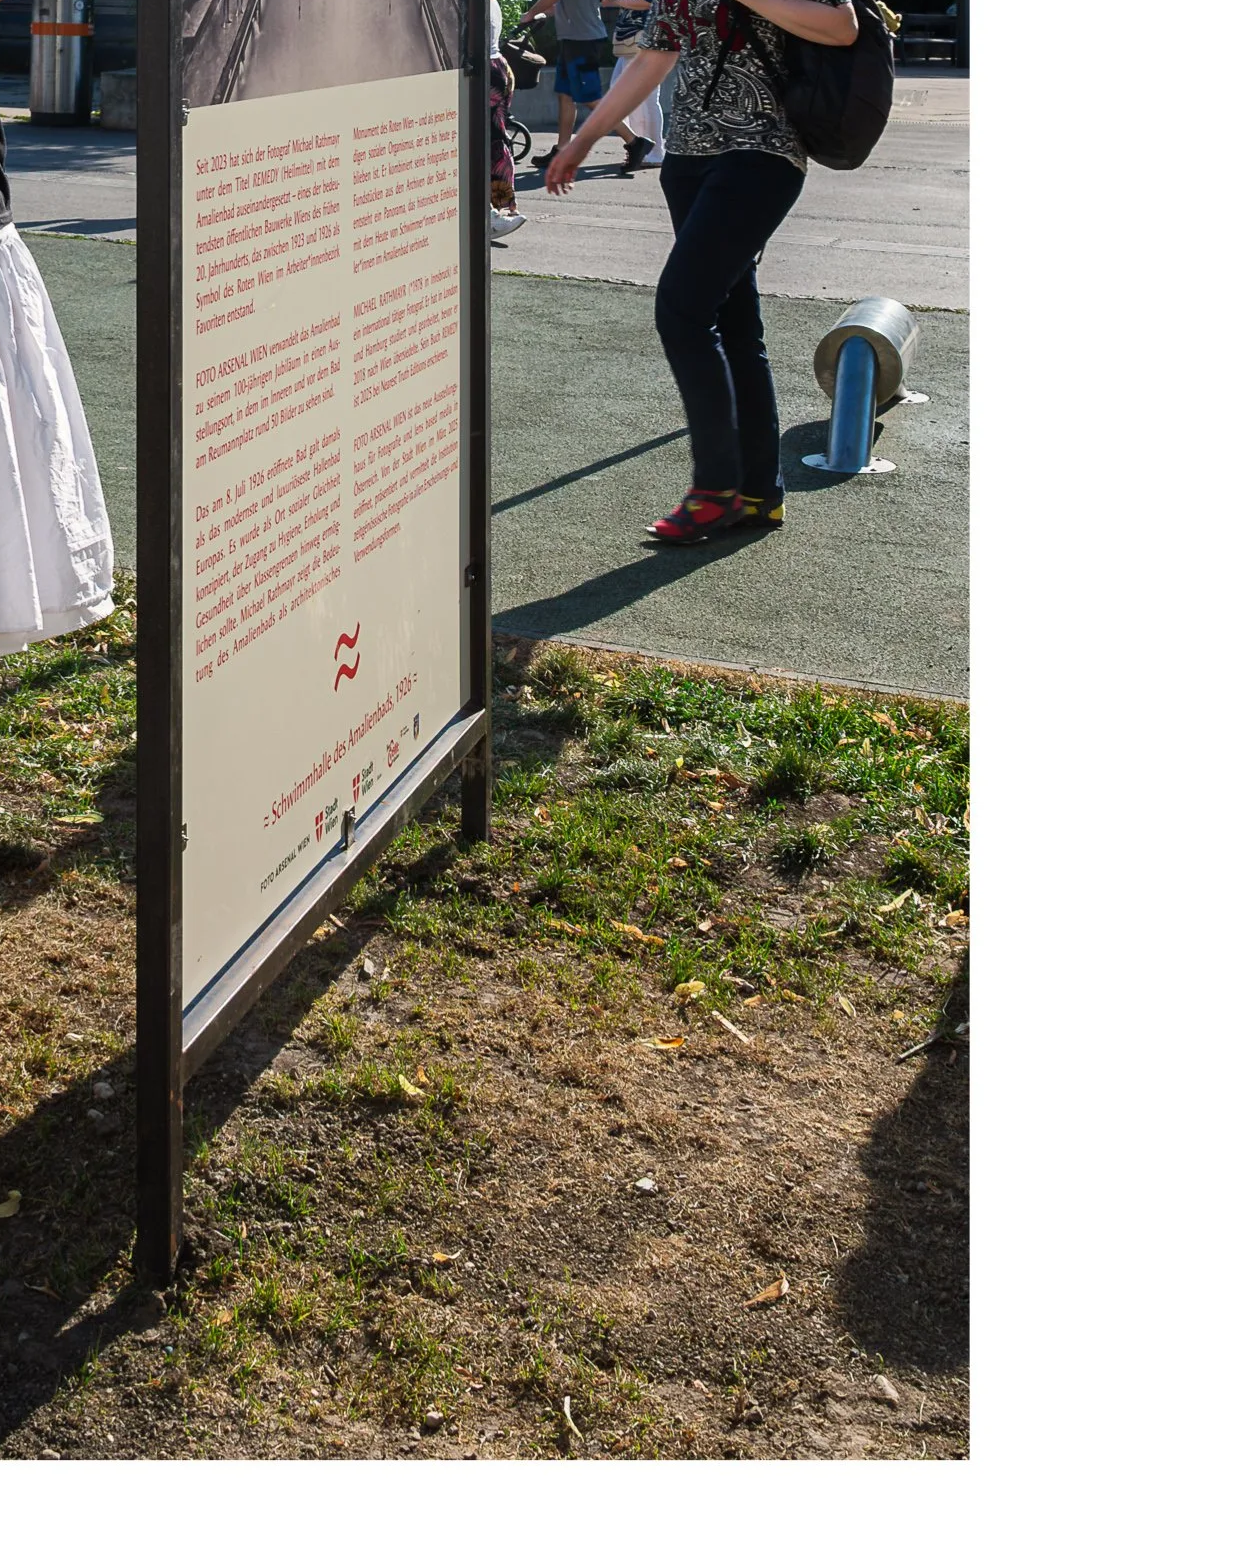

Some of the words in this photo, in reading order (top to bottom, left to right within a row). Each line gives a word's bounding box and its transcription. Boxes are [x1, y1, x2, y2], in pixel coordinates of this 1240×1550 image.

[196, 158, 209, 175] Seit
[210, 153, 227, 171] 2023
[229, 152, 240, 167] hat
[241, 147, 254, 165] sich
[255, 146, 266, 161] der
[267, 139, 291, 160] Fotograf
[291, 135, 314, 152] Michael
[195, 203, 235, 228] Amalienbad
[236, 191, 291, 216] auseinandergesetzt
[297, 186, 311, 200] eines
[196, 186, 215, 201] unter
[217, 180, 232, 196] dem
[234, 173, 249, 191] Titel
[252, 168, 279, 187] REMEDY
[195, 235, 224, 255] tendsten
[226, 223, 262, 245] öffentlichen
[264, 213, 292, 233] Bauwerke
[293, 209, 311, 224] Wiens
[195, 264, 207, 281] 20.
[251, 247, 262, 263] das
[263, 240, 289, 259] zwischen
[290, 232, 305, 249] 1923
[306, 228, 317, 244] und
[195, 285, 221, 311] Symbol
[223, 282, 234, 298] des
[236, 277, 255, 293] Roten
[257, 269, 273, 285] Wien
[275, 265, 284, 279] im
[353, 297, 377, 317] MICHAEL
[196, 313, 225, 334] Favoriten
[226, 298, 255, 322] entstand.
[196, 366, 216, 388] FOTO
[217, 352, 248, 378] ARSENAL
[249, 343, 268, 364] WIEN
[269, 330, 299, 355] verwandelt
[299, 326, 309, 342] das
[195, 401, 204, 415] zu
[206, 389, 231, 410] seinem
[275, 357, 301, 381] Jubiläum
[303, 350, 309, 364] in
[236, 406, 243, 421] in
[244, 401, 259, 417] dem
[260, 395, 269, 409] im
[270, 385, 292, 403] Inneren
[294, 374, 305, 392] und
[306, 373, 316, 385] vor
[195, 453, 207, 468] am
[208, 428, 254, 461] Reumannplatz
[255, 415, 270, 437] rund
[271, 412, 279, 429] 50
[280, 405, 297, 424] Bilder
[297, 402, 305, 414] zu
[353, 432, 368, 451] FOTO
[369, 419, 392, 441] ARSENAL
[393, 410, 406, 427] WIEN
[195, 505, 209, 522] Das
[211, 497, 223, 512] am
[226, 488, 233, 504] 8.
[235, 479, 246, 503] Juli
[249, 469, 265, 490] 1926
[295, 444, 307, 463] Bad
[195, 530, 205, 549] als
[208, 523, 221, 540] das
[223, 502, 258, 531] modernste
[261, 487, 274, 508] und
[196, 548, 225, 575] Europas.
[228, 538, 236, 554] Es
[239, 523, 260, 547] wurde
[263, 515, 272, 532] als
[274, 508, 286, 524] Ort
[288, 493, 310, 516] sozialer
[232, 561, 243, 577] der
[244, 545, 268, 569] Zugang
[268, 540, 276, 553] zu
[195, 592, 234, 628] Gesundheit
[236, 581, 252, 600] über
[195, 632, 216, 655] lichen
[218, 617, 238, 639] sollte.
[240, 593, 265, 623] Michael
[267, 575, 296, 603] Rathmayr
[297, 563, 311, 582] zeigt
[195, 661, 213, 682] tung
[216, 649, 229, 666] des
[232, 612, 276, 654] Amalienbads
[278, 602, 287, 620] als
[271, 752, 332, 825] Schwimmhalle
[334, 740, 347, 764] des
[348, 691, 395, 751] Amalienbads,
[396, 672, 412, 703] 1926
[361, 761, 374, 782] Stadt
[325, 797, 339, 820] Stadt
[361, 778, 374, 797] Wien
[325, 814, 339, 835] Wien
[260, 871, 274, 894] FOTO
[275, 851, 297, 878] ARSENAL
[298, 834, 311, 854] WIEN
